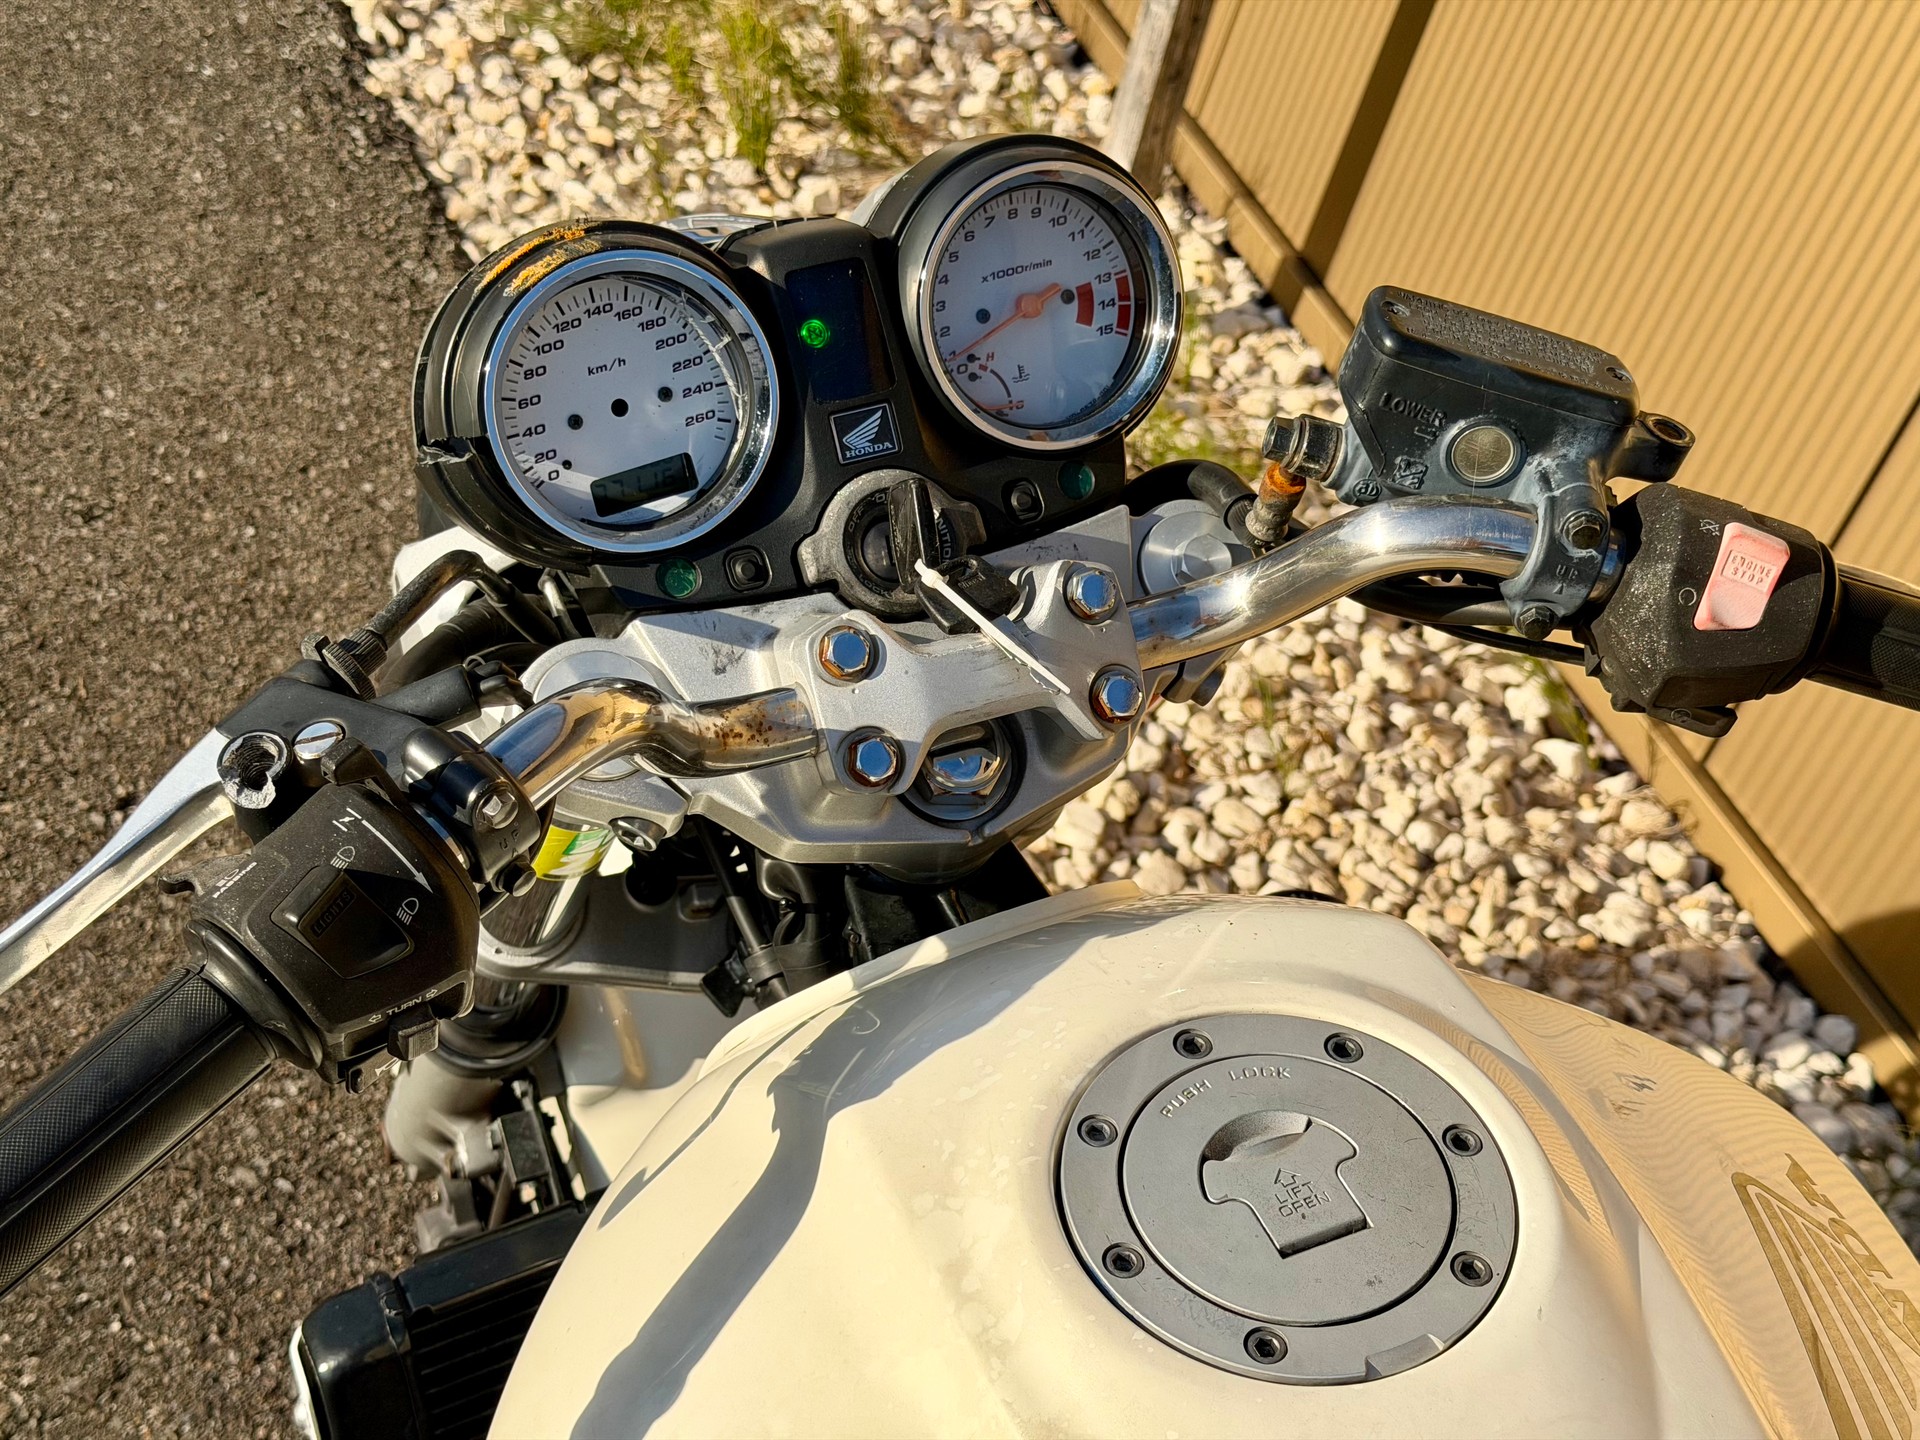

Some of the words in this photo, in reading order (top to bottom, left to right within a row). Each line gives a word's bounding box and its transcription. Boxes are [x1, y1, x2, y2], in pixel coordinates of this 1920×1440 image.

[1007, 208, 1018, 220] 8
[1031, 207, 1042, 219] 9
[984, 216, 995, 229] 7
[1048, 215, 1067, 228] 10
[964, 231, 975, 242] 6
[1068, 229, 1086, 242] 11
[948, 251, 959, 263] 5
[1083, 248, 1102, 261] 12
[938, 274, 950, 285] 4
[1094, 272, 1112, 284] 13
[583, 303, 614, 319] 140
[935, 301, 946, 312] 3
[1098, 298, 1116, 310] 14
[614, 306, 643, 322] 160
[552, 317, 582, 333] 120
[638, 316, 667, 333] 180
[940, 326, 951, 337] 2
[1096, 324, 1114, 336] 15
[533, 339, 564, 356] 100
[655, 333, 688, 350] 200
[672, 356, 703, 373] 220
[986, 352, 995, 362] H
[523, 365, 547, 381] 80
[587, 357, 627, 377] km/h
[956, 363, 968, 375] 0
[682, 381, 714, 399] 240
[518, 394, 541, 410] 60
[685, 409, 716, 428] 260
[1379, 392, 1448, 431] LOWER
[522, 423, 546, 439] 40
[534, 449, 557, 465] 20
[844, 441, 893, 459] HONDA
[548, 469, 560, 482] 0
[848, 502, 865, 532] OFF
[1731, 555, 1773, 578] ENGINE
[1731, 566, 1764, 585] STOP
[860, 574, 891, 599] LOCK
[314, 889, 352, 935] LIGHTS
[385, 996, 422, 1016] TURN
[1160, 1079, 1212, 1118] PUSH
[1228, 1066, 1291, 1081] LOCK
[1274, 1180, 1315, 1205] LIFT
[1278, 1190, 1332, 1218] OPEN
